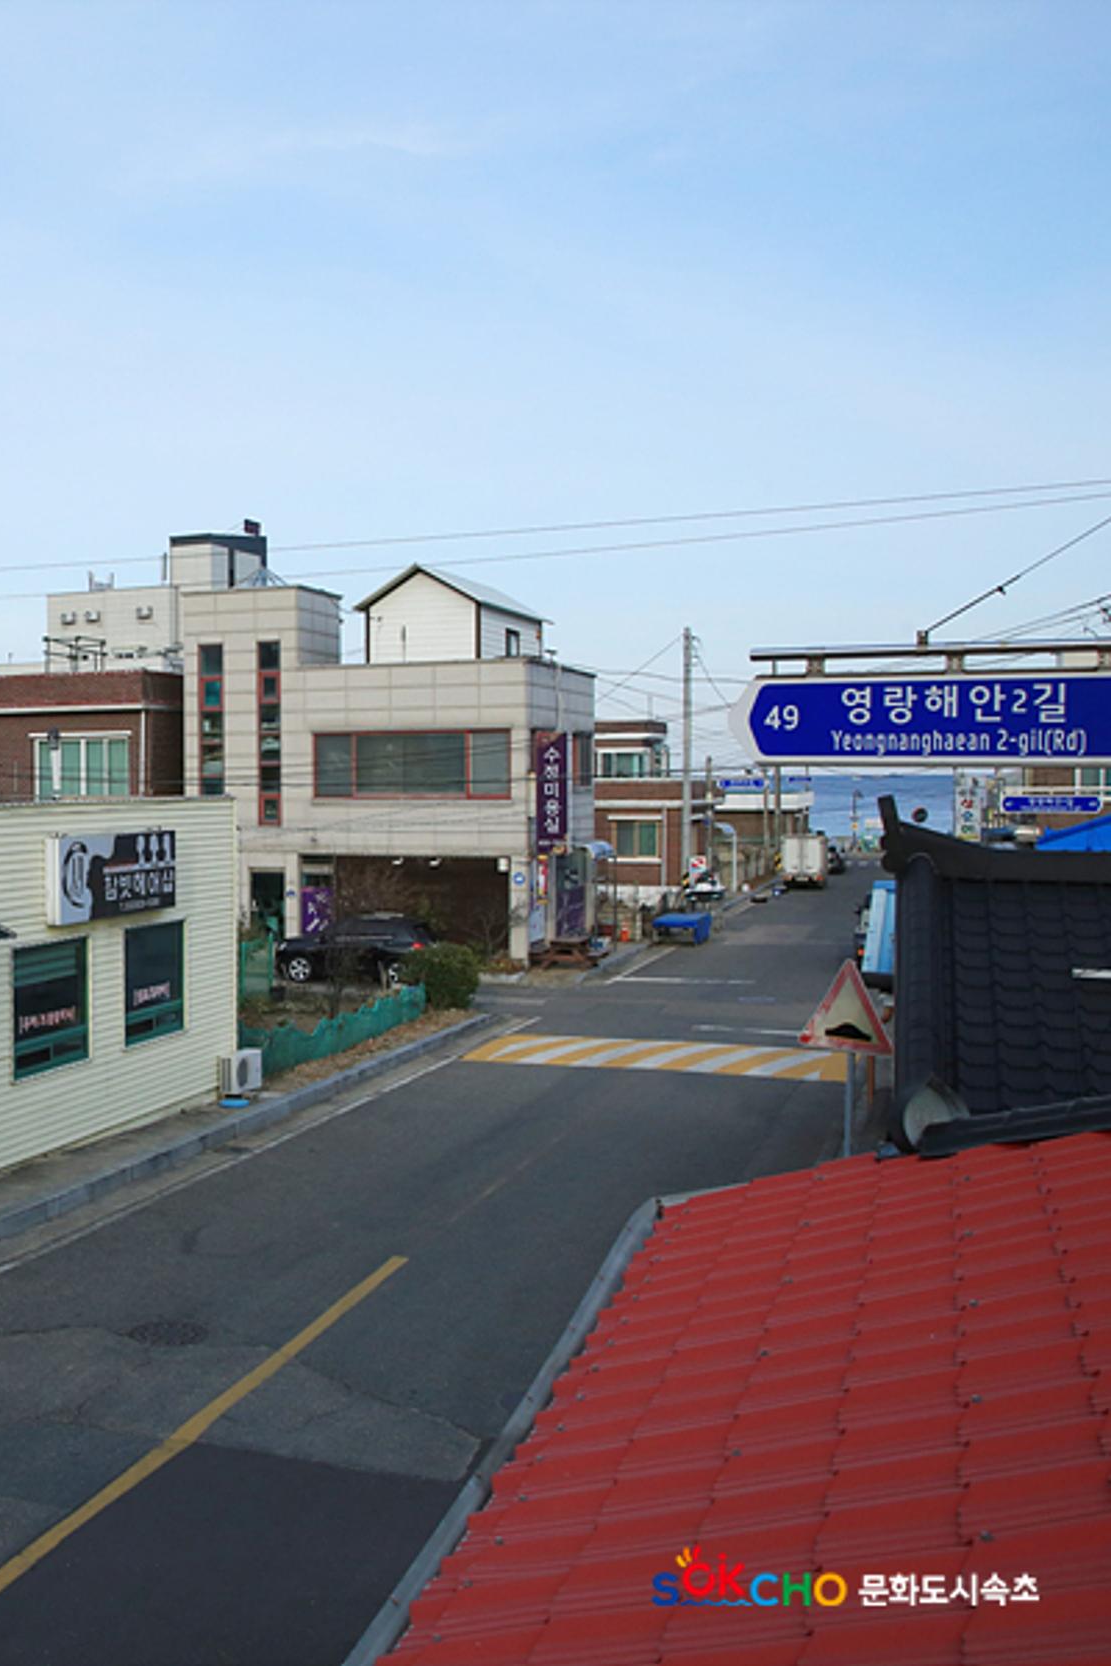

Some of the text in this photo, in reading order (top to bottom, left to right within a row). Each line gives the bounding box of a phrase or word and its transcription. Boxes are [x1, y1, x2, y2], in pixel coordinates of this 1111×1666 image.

[762, 704, 800, 731] 49
[840, 682, 1067, 725] 영랑해안2길
[830, 728, 1087, 757] Yeongnanghaean 2-gil(Rd)
